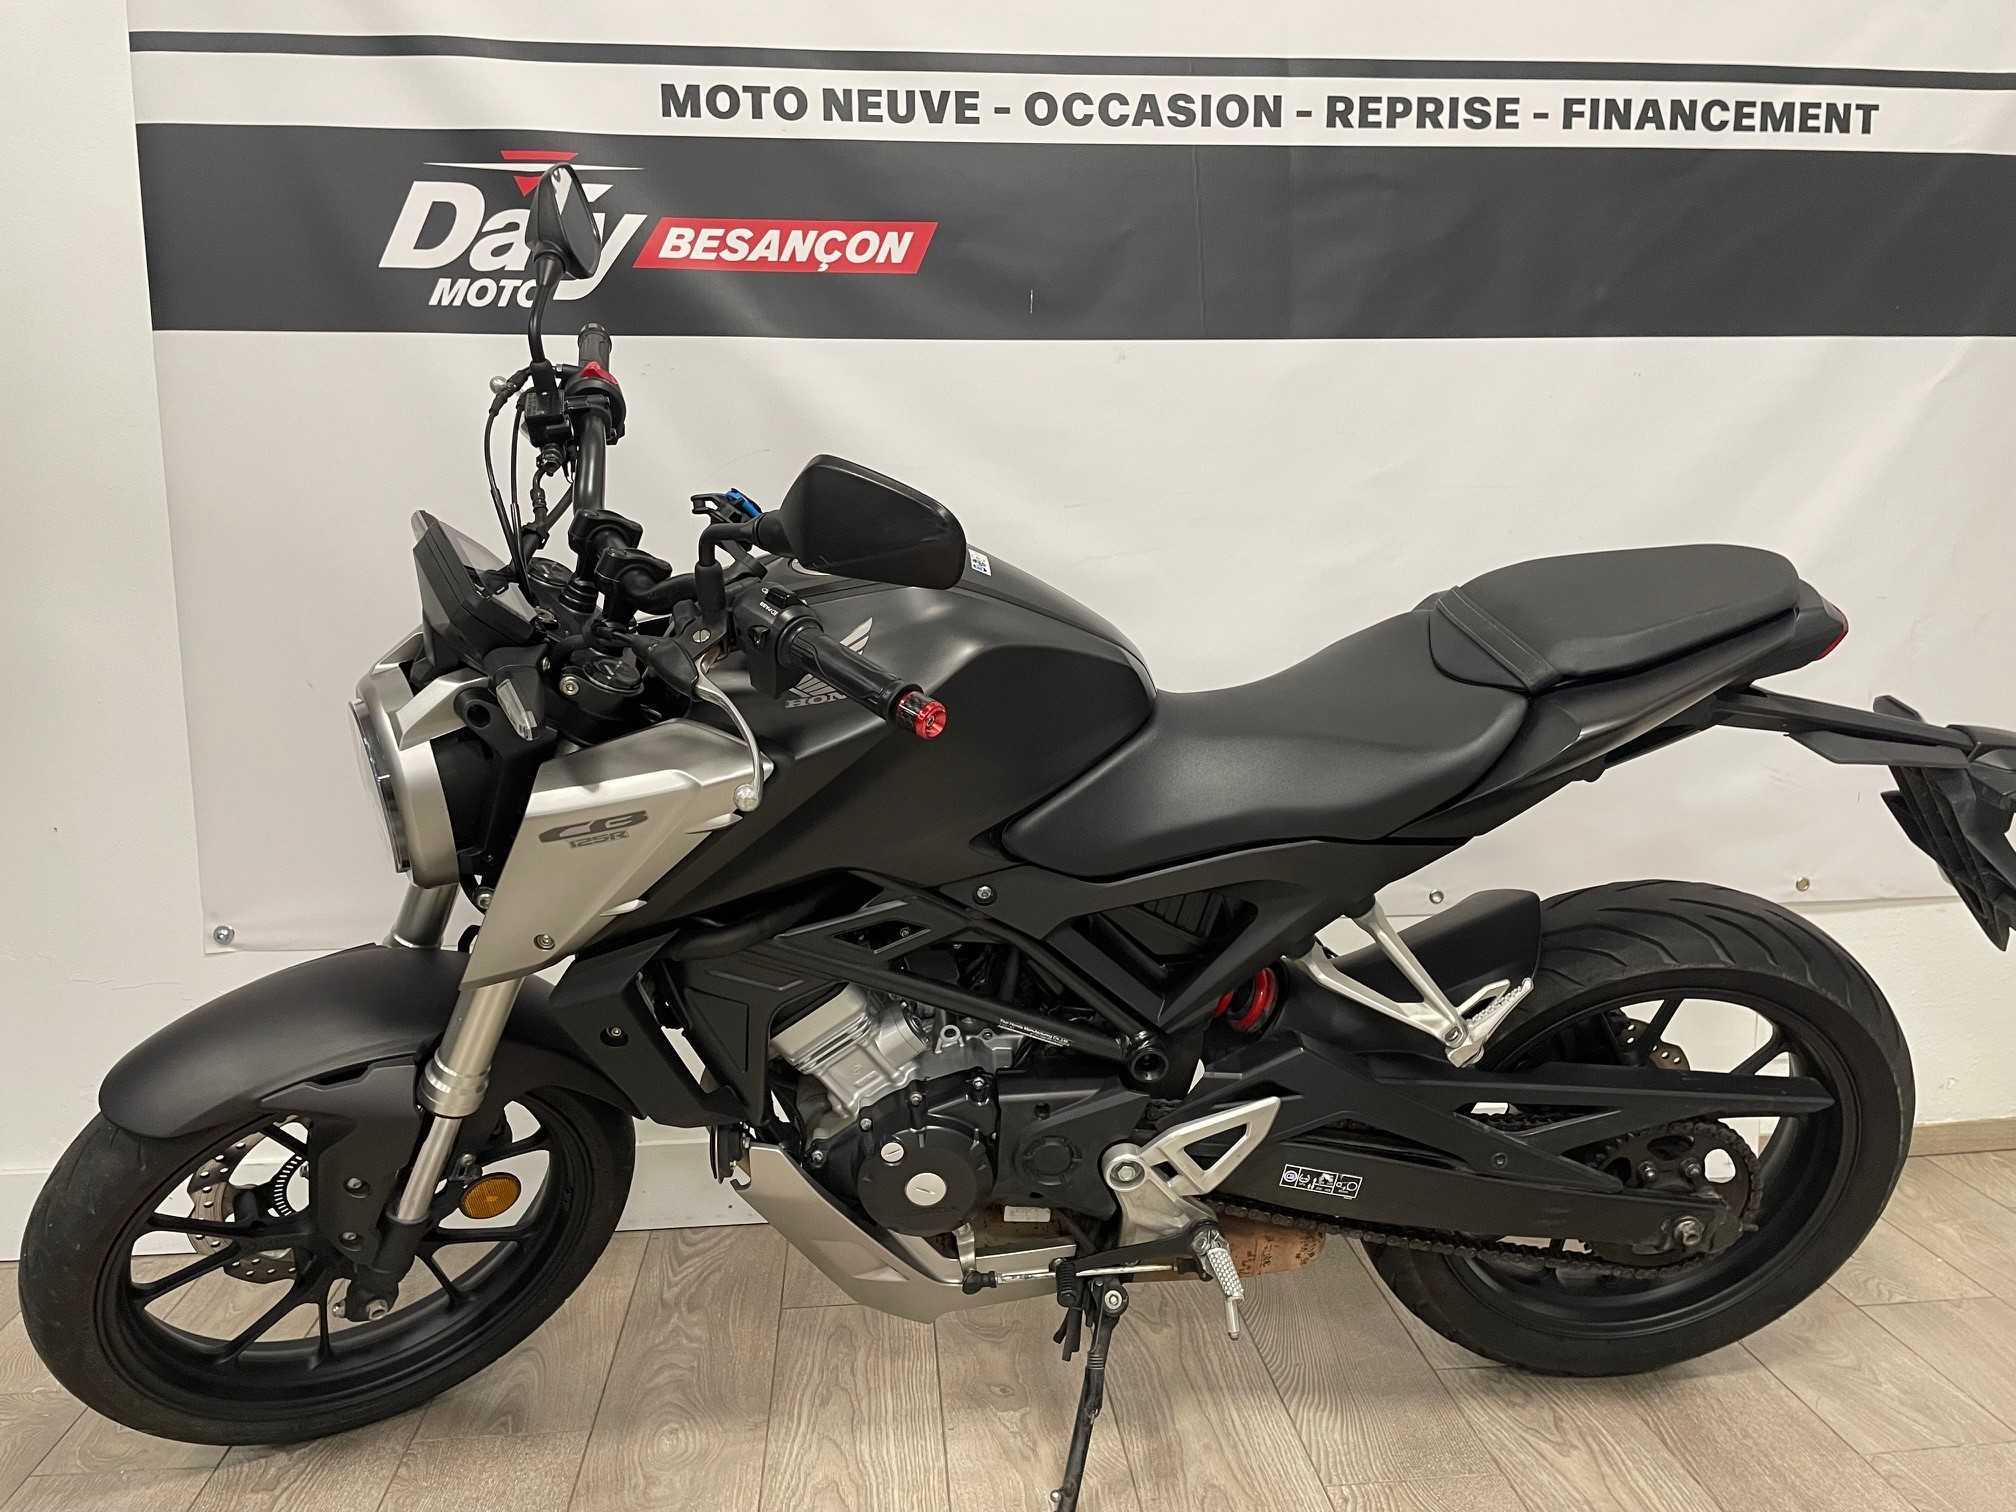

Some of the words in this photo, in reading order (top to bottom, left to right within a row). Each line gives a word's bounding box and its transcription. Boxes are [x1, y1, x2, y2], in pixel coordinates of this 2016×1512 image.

[660, 83, 808, 122] MOTO
[822, 87, 980, 125] NEUVE
[993, 106, 1011, 115] -
[1024, 91, 1283, 128] OCCASION
[1295, 110, 1313, 118] -
[1325, 95, 1521, 130] REPRISE
[1533, 112, 1549, 120] -
[1562, 97, 1880, 135] FINANCEMENT
[378, 180, 649, 301] Day
[658, 226, 915, 272] BESANÇON
[784, 692, 849, 708] HON
[539, 810, 648, 843] CB
[570, 831, 629, 848] 125R
